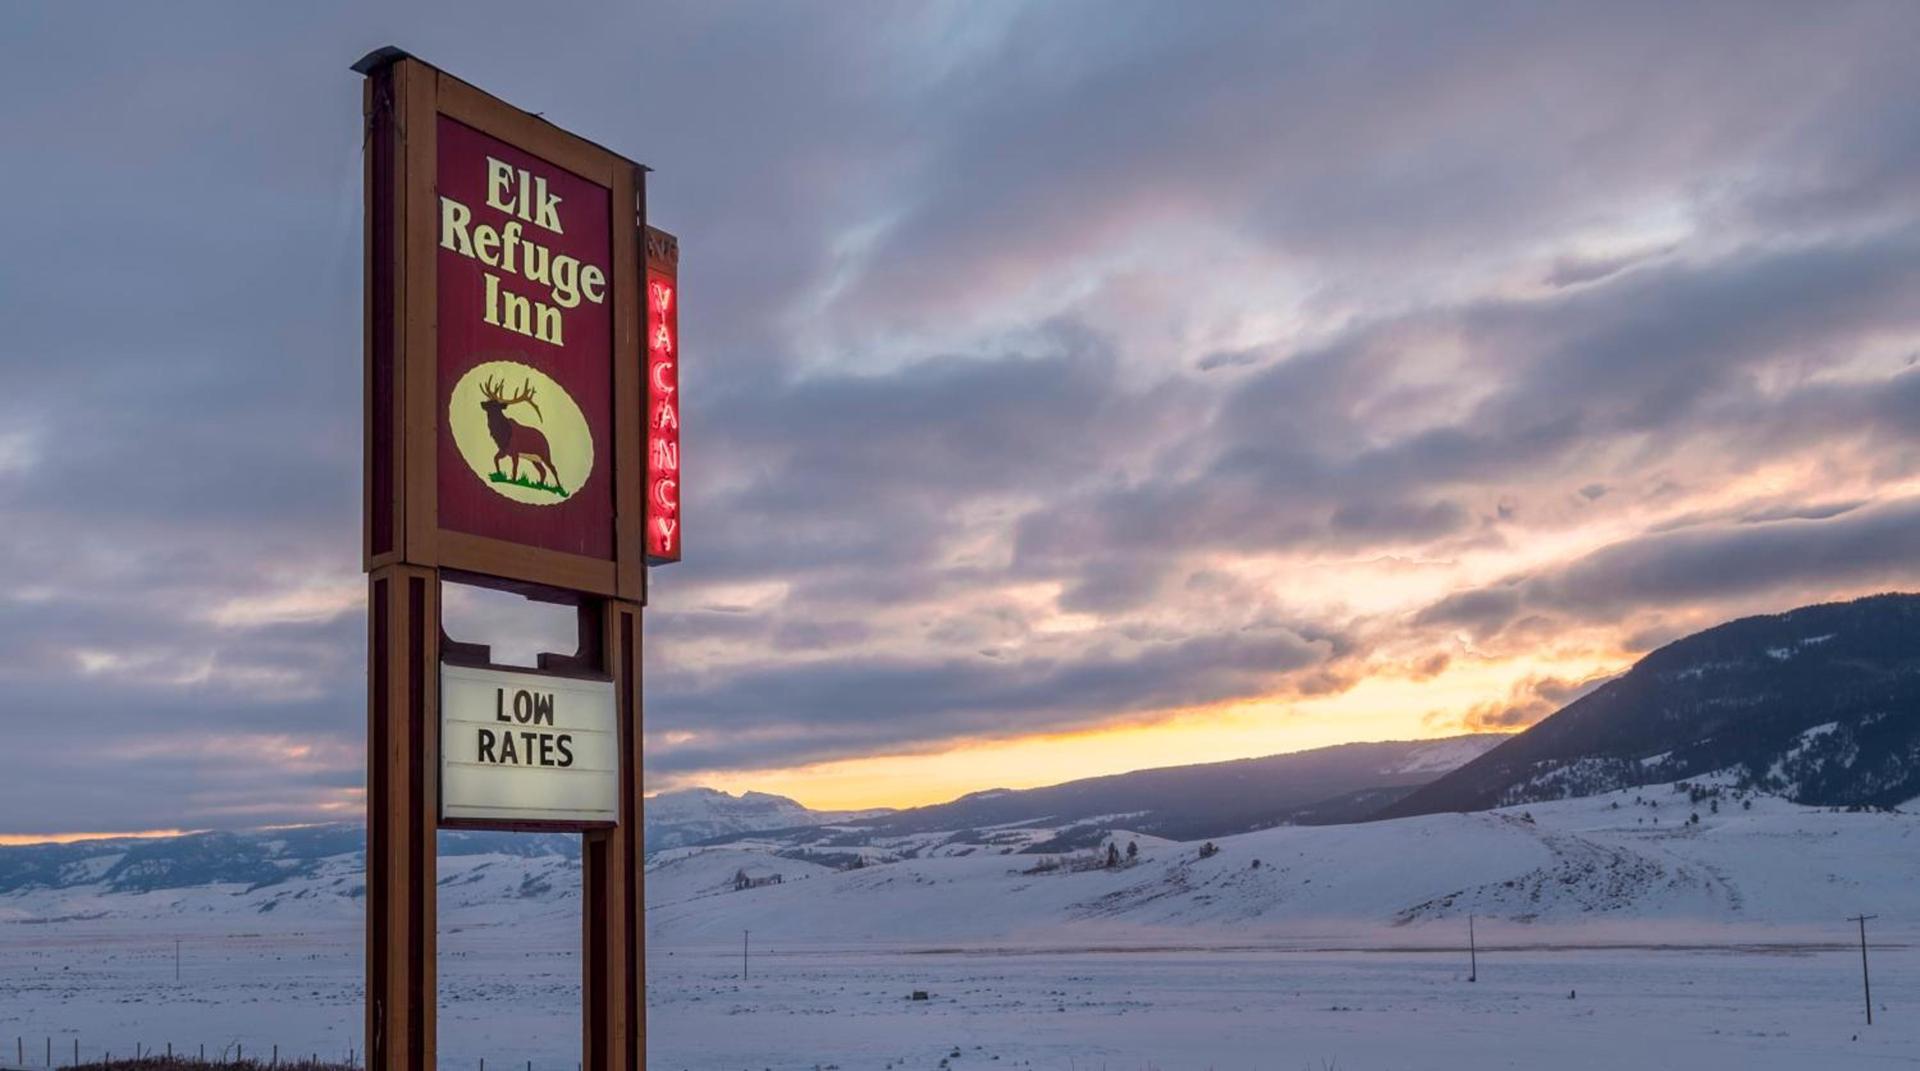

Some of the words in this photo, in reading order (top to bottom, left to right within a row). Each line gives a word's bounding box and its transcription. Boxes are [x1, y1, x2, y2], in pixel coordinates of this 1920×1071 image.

[486, 156, 564, 234] Elk
[440, 196, 605, 308] Refuge
[484, 273, 564, 346] Inn
[652, 282, 677, 551] VACANCY
[497, 688, 554, 726] LOW
[478, 729, 573, 767] RATES
